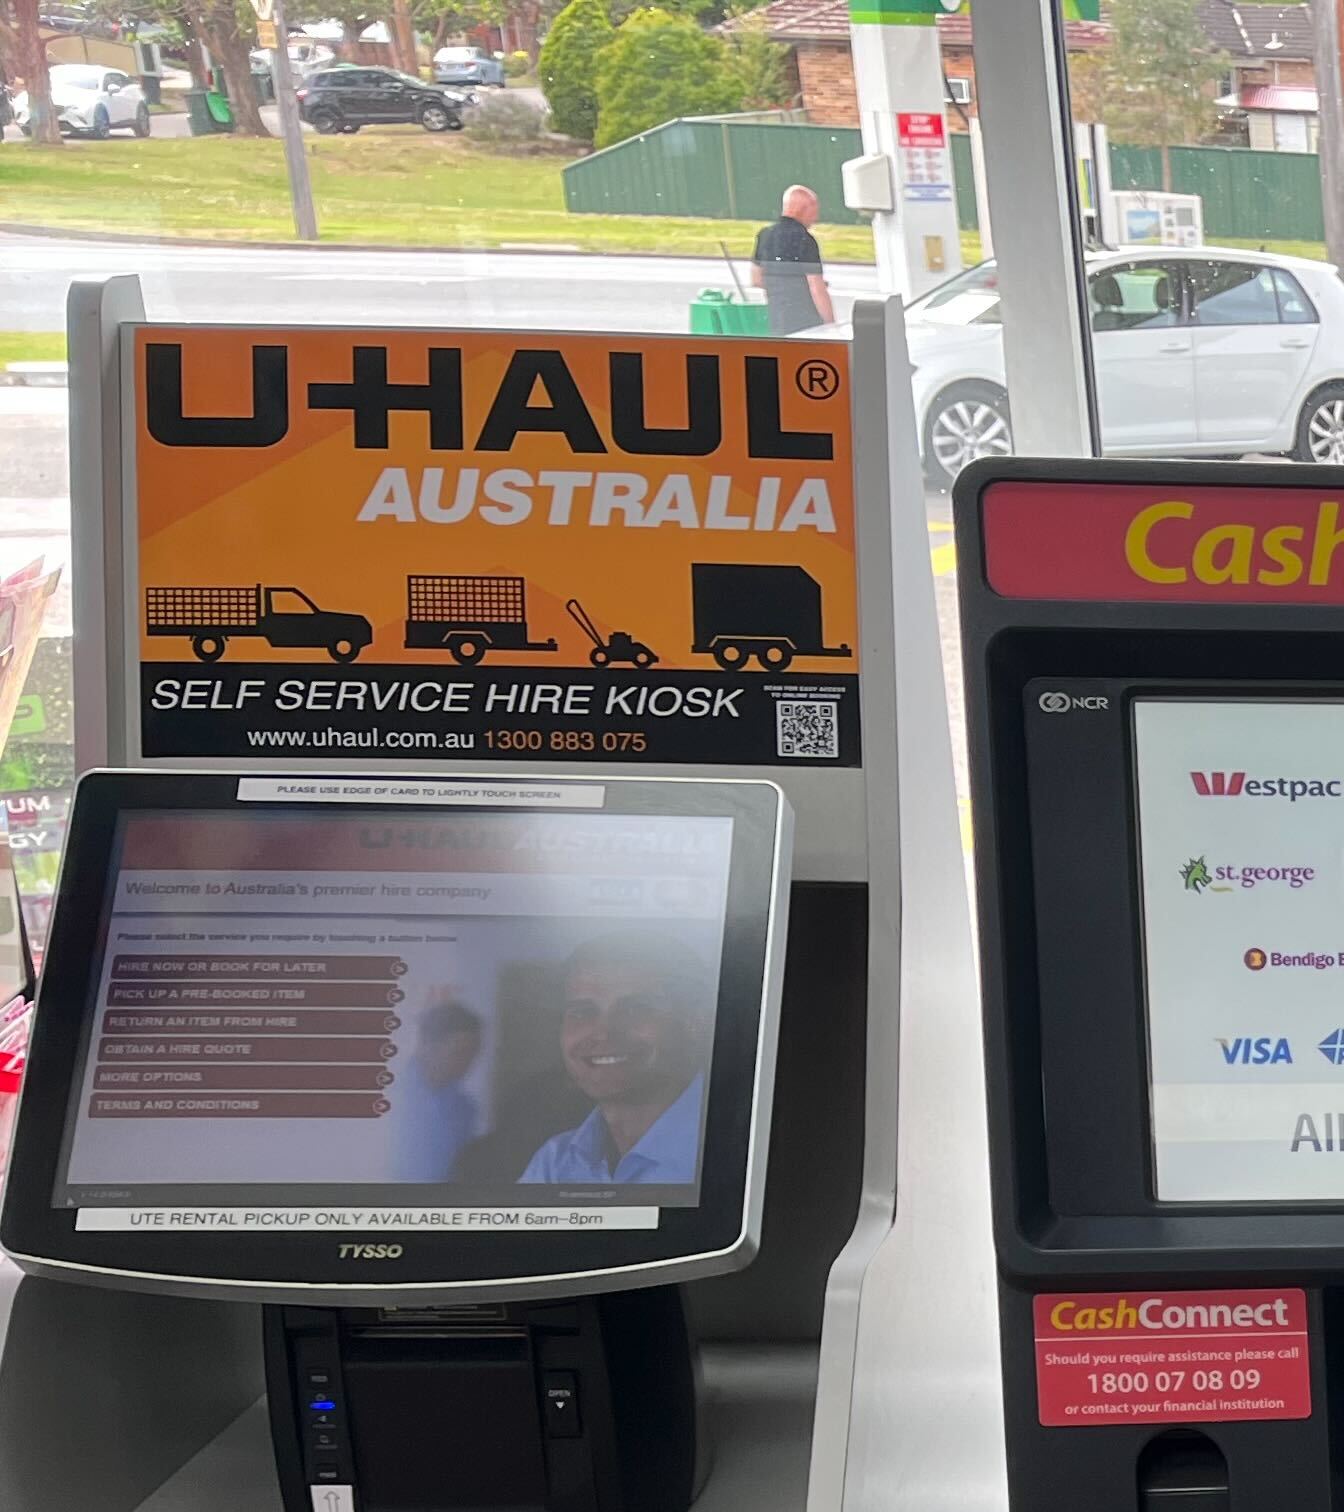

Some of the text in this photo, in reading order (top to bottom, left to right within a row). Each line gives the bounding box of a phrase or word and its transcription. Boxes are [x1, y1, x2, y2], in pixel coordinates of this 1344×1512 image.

[356, 467, 837, 532] AUSTRALIA
[151, 679, 265, 710] SELF
[275, 680, 475, 713] SERVICE
[484, 683, 594, 715] HIRE
[604, 685, 745, 718] KIOSK
[1072, 696, 1110, 710] NCR
[247, 727, 647, 752] www.uhaul.com.au 1300 883 075
[1190, 771, 1341, 801] Westpac
[1271, 952, 1335, 970] Bendigo
[1215, 1037, 1294, 1065] VISA
[130, 1212, 165, 1226] UTE
[169, 1212, 240, 1226] RENTAL
[243, 1212, 311, 1227] PICKUP
[315, 1212, 362, 1226] ONLY
[367, 1212, 462, 1226] AVAILABLE
[468, 1212, 520, 1226] FROM
[337, 1243, 403, 1260] TYSSO
[1045, 1347, 1299, 1368] Should you require assistance please call
[1087, 1369, 1261, 1394] 1800 07 08 09
[1064, 1398, 1285, 1419] or contact your financial institution
